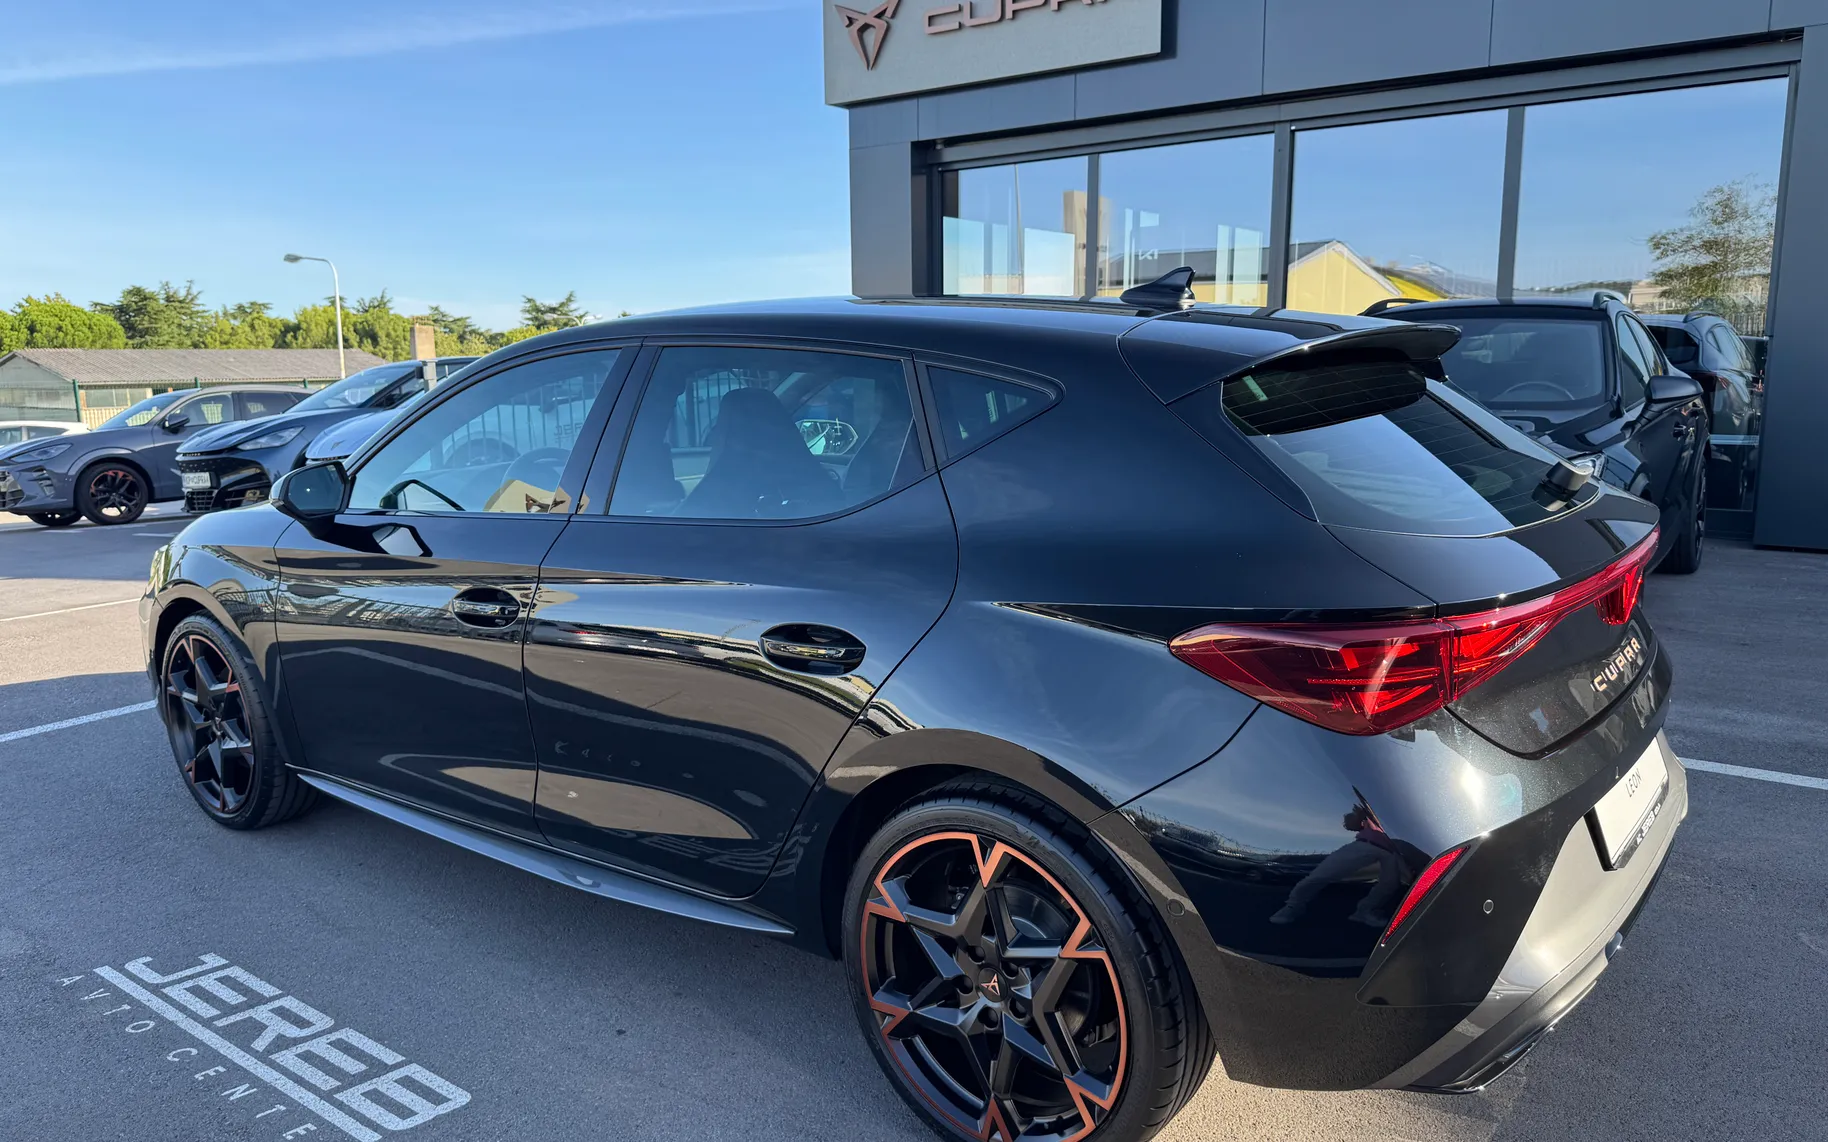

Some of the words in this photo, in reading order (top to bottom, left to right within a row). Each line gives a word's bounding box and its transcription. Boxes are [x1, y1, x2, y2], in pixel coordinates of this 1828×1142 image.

[924, 0, 1107, 35] CUP
[1593, 637, 1641, 691] CUPRA
[1625, 767, 1642, 797] LEON
[56, 974, 156, 1036] AVTO
[124, 952, 472, 1131] JEREB
